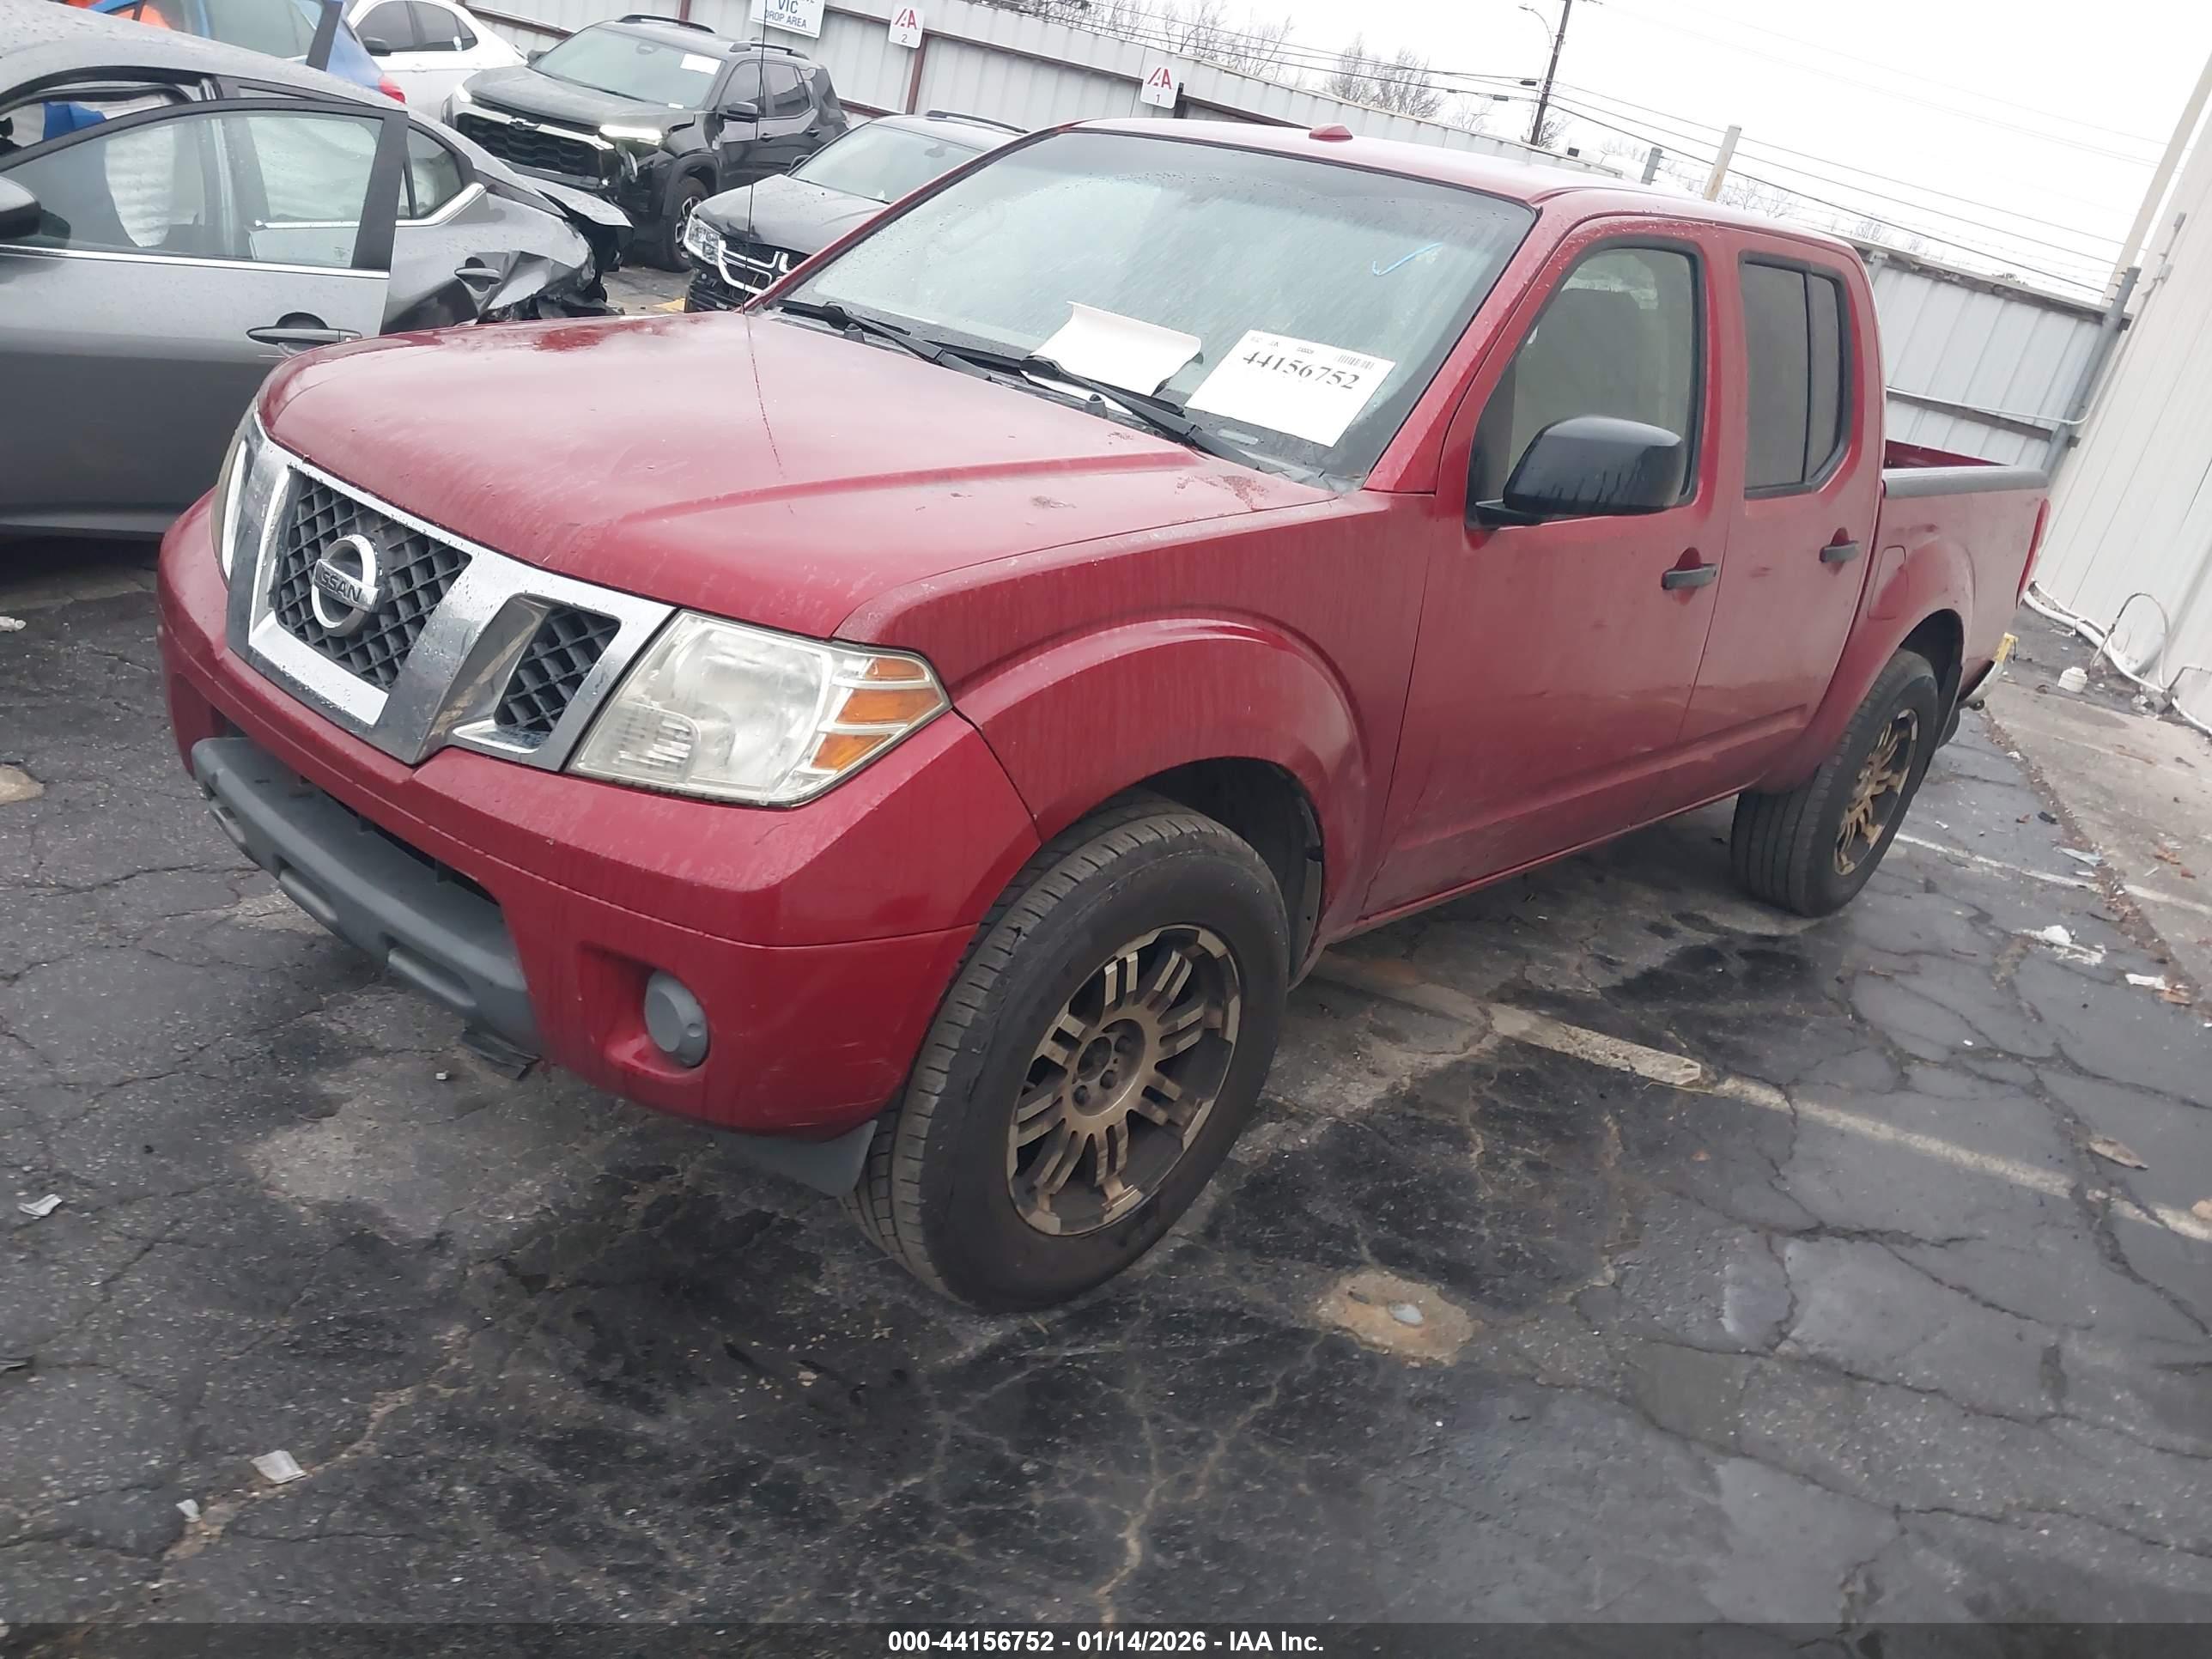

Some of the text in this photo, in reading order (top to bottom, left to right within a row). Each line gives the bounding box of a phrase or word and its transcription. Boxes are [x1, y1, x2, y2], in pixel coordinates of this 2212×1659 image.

[778, 0, 799, 14] VIC
[764, 9, 807, 28] DROP AREA
[901, 33, 908, 44] 2
[1243, 350, 1360, 389] 44156752
[316, 565, 363, 601] SSAN
